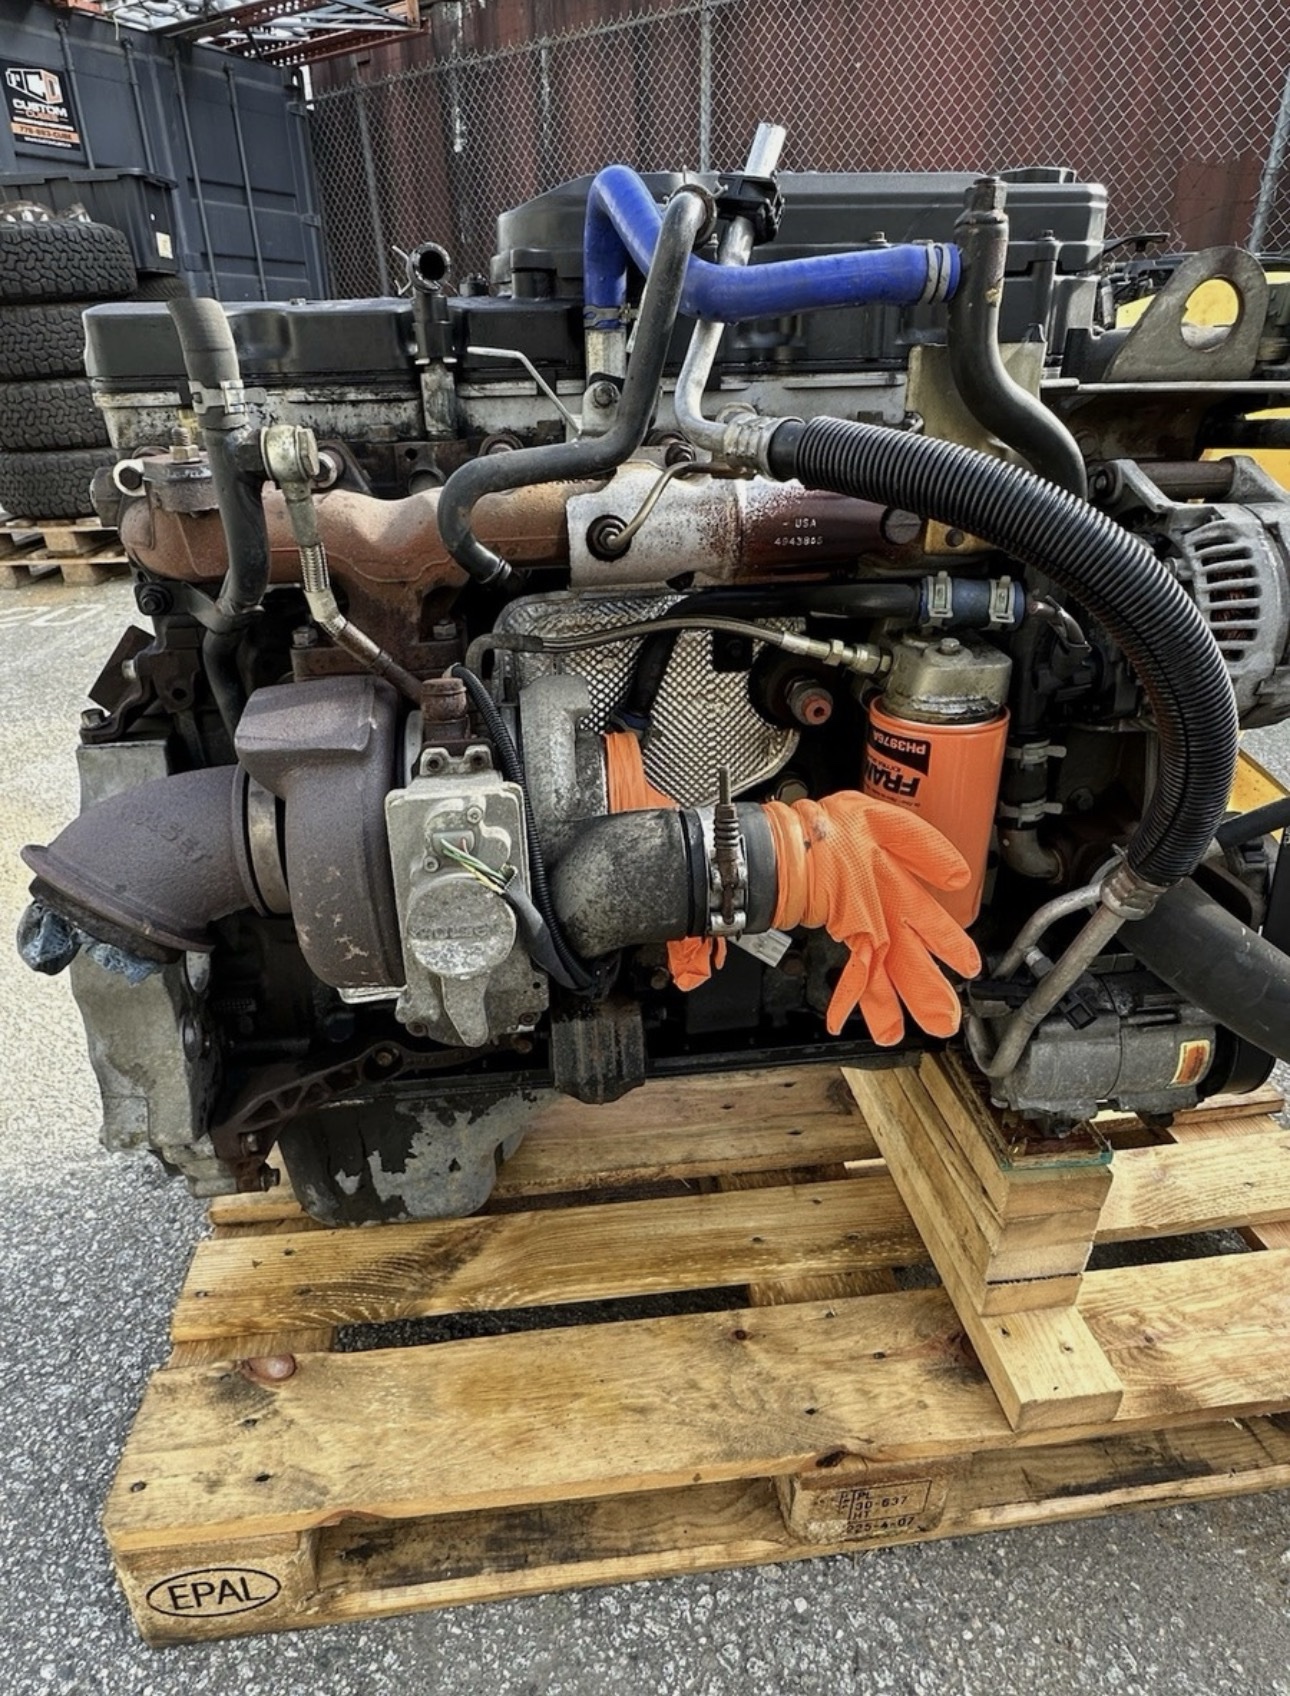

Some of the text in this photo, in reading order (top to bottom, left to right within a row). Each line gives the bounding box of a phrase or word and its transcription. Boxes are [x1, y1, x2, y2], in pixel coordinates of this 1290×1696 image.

[13, 98, 68, 118] CUSTOM
[795, 517, 816, 528] USA
[855, 1495, 908, 1511] 30-637
[168, 1576, 266, 1610] EPAL
